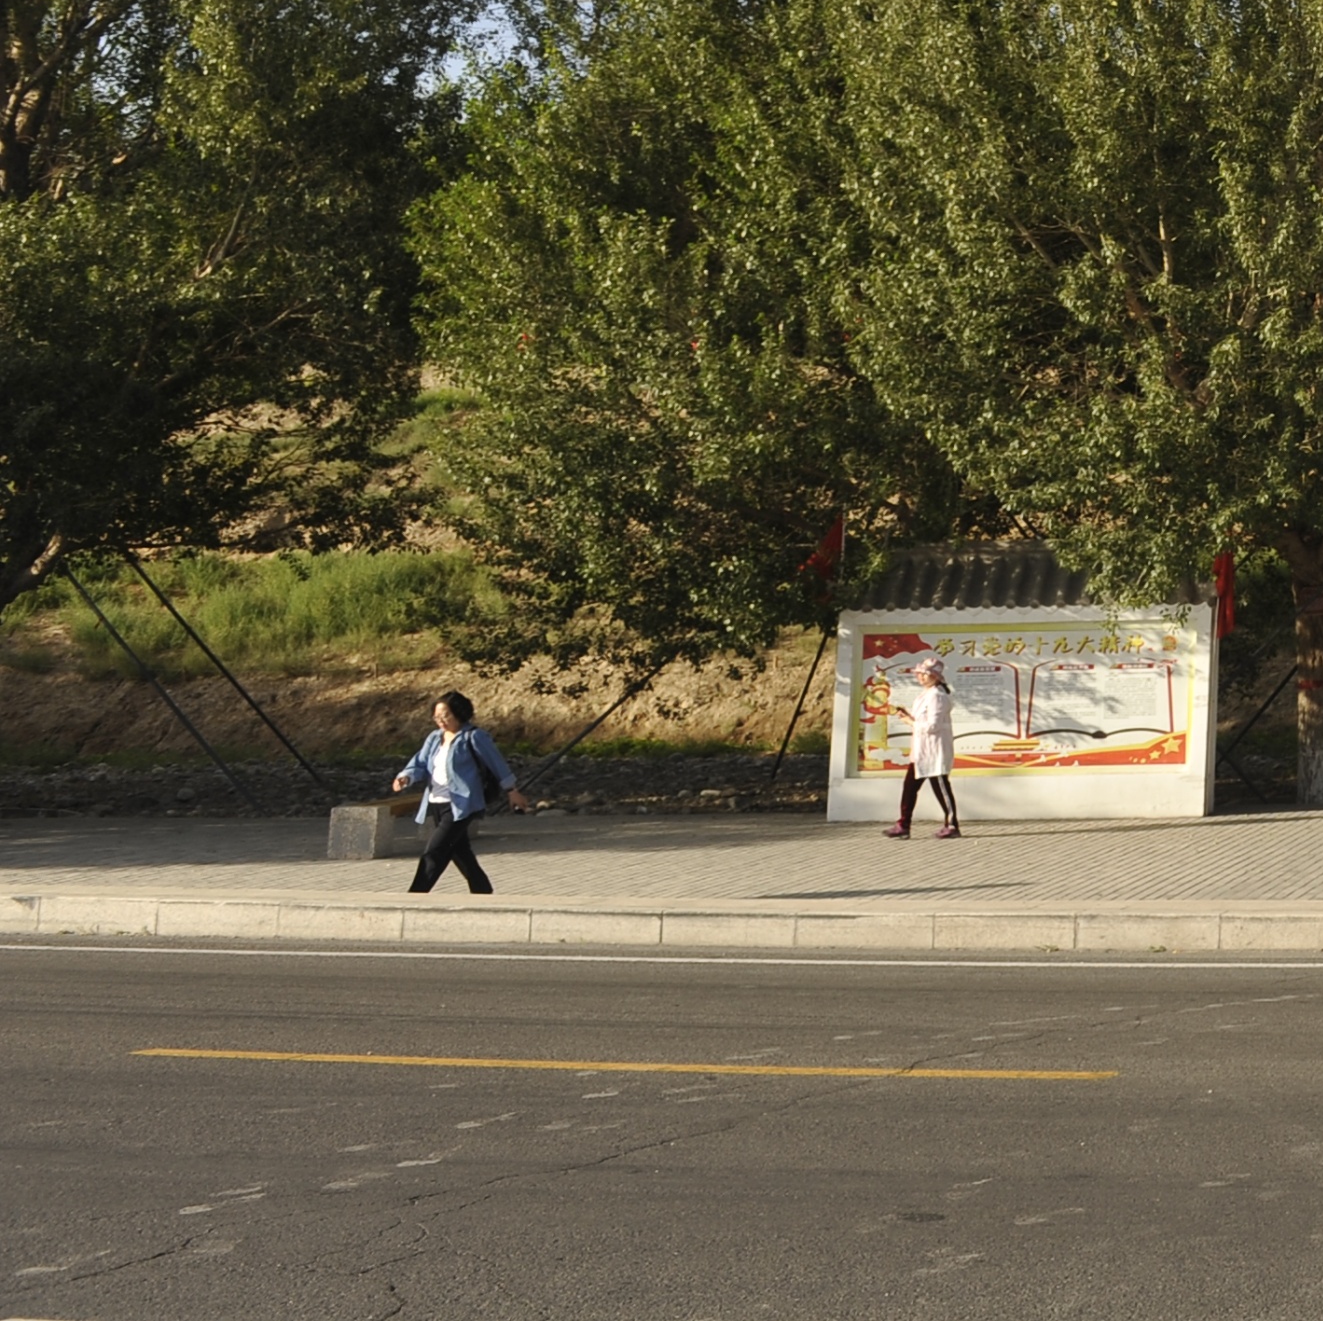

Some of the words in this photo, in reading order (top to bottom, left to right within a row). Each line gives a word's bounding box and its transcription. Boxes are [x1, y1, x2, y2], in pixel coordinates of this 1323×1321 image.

[934, 634, 1145, 657] 学习党的十九大精神
